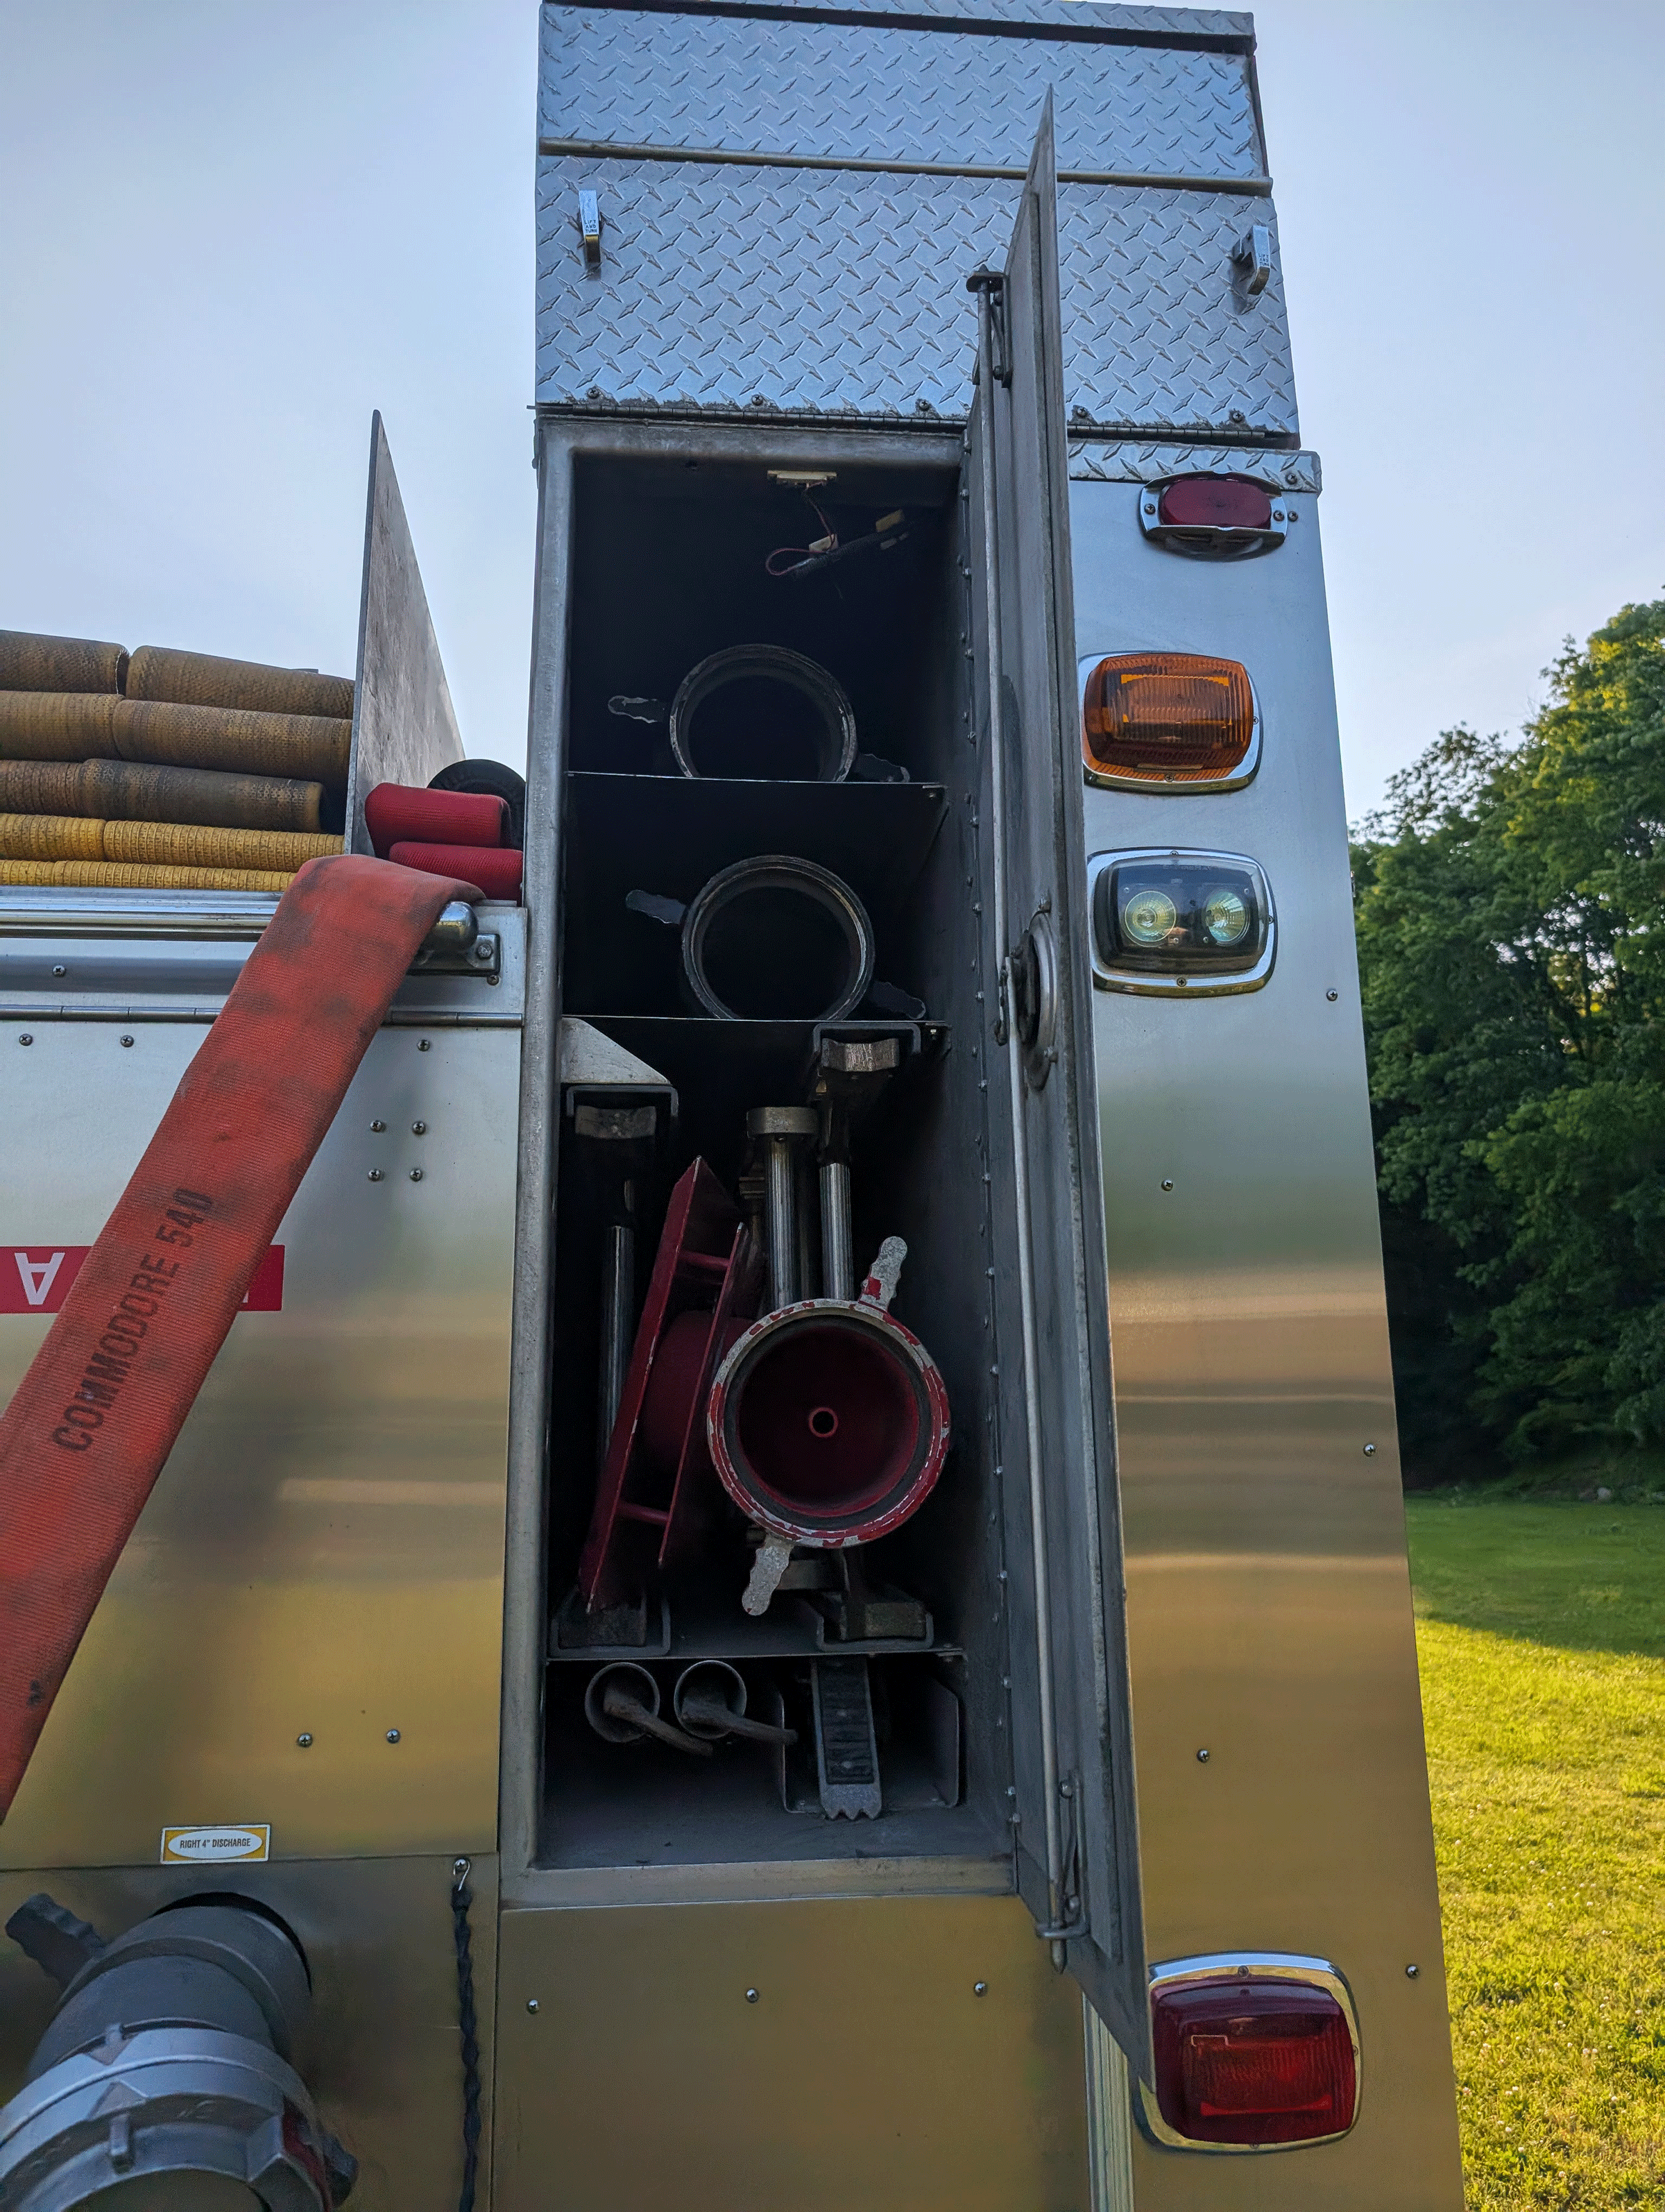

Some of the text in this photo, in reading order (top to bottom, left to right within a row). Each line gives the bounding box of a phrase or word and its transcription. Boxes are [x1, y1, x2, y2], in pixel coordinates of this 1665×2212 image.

[52, 1188, 213, 1452] COMMODORE 540
[180, 1838, 250, 1848] RIGHT 4" DISCHARGE
